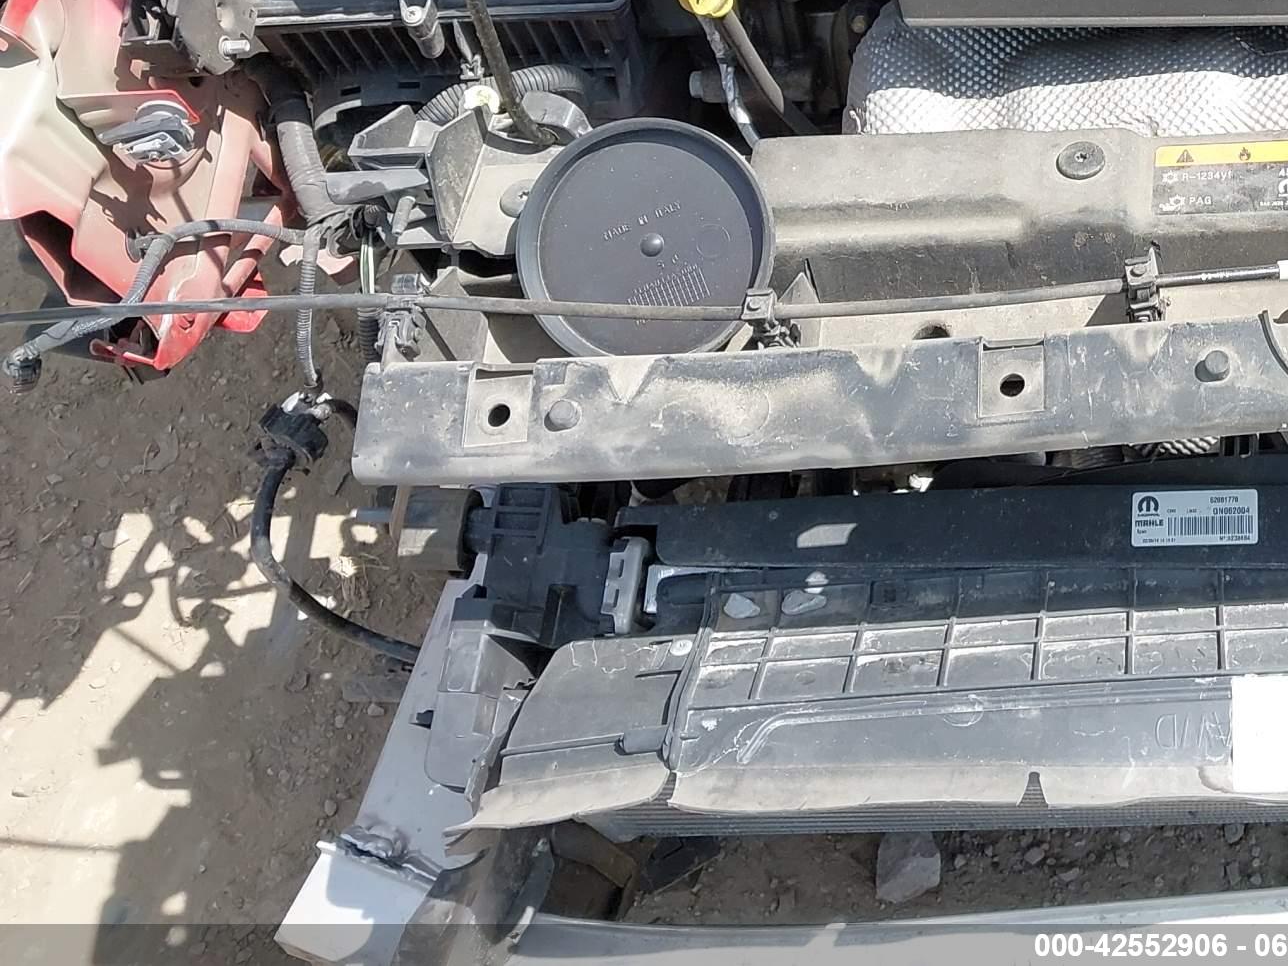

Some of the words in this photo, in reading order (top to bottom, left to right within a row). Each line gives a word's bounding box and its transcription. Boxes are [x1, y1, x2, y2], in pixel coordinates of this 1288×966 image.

[1182, 170, 1232, 182] R-1234yf
[1189, 196, 1212, 205] PAG
[1135, 519, 1164, 528] MAHLE
